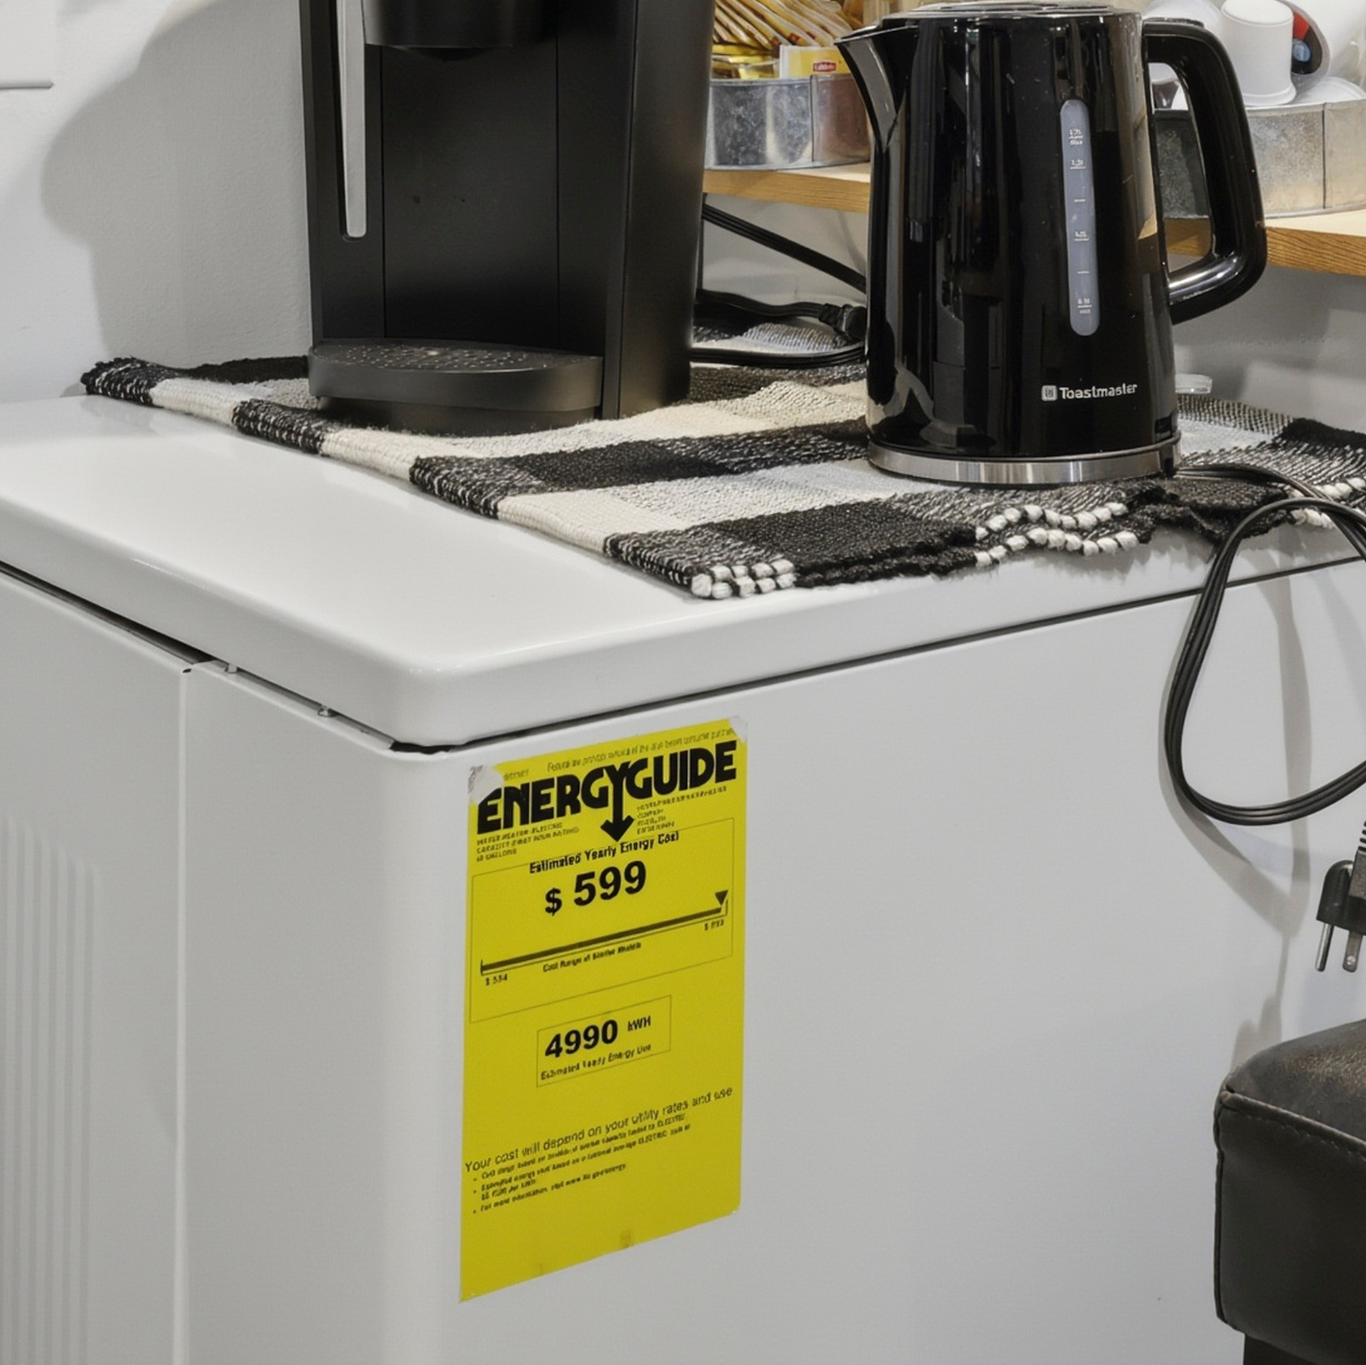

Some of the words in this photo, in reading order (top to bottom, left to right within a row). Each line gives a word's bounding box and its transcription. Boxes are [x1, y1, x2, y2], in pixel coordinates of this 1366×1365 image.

[1059, 383, 1138, 400] Toastmaster
[477, 740, 737, 841] ENERGYGUIDE
[585, 845, 617, 862] Yearly
[620, 838, 654, 854] Energy
[545, 887, 562, 916] $
[574, 860, 647, 906] 599
[545, 1019, 618, 1058] 4990
[465, 1157, 491, 1173] Your
[495, 1148, 519, 1165] cost
[543, 1129, 585, 1151] depend
[587, 1127, 602, 1138] on
[605, 1117, 629, 1134] your
[662, 1100, 689, 1116] rates
